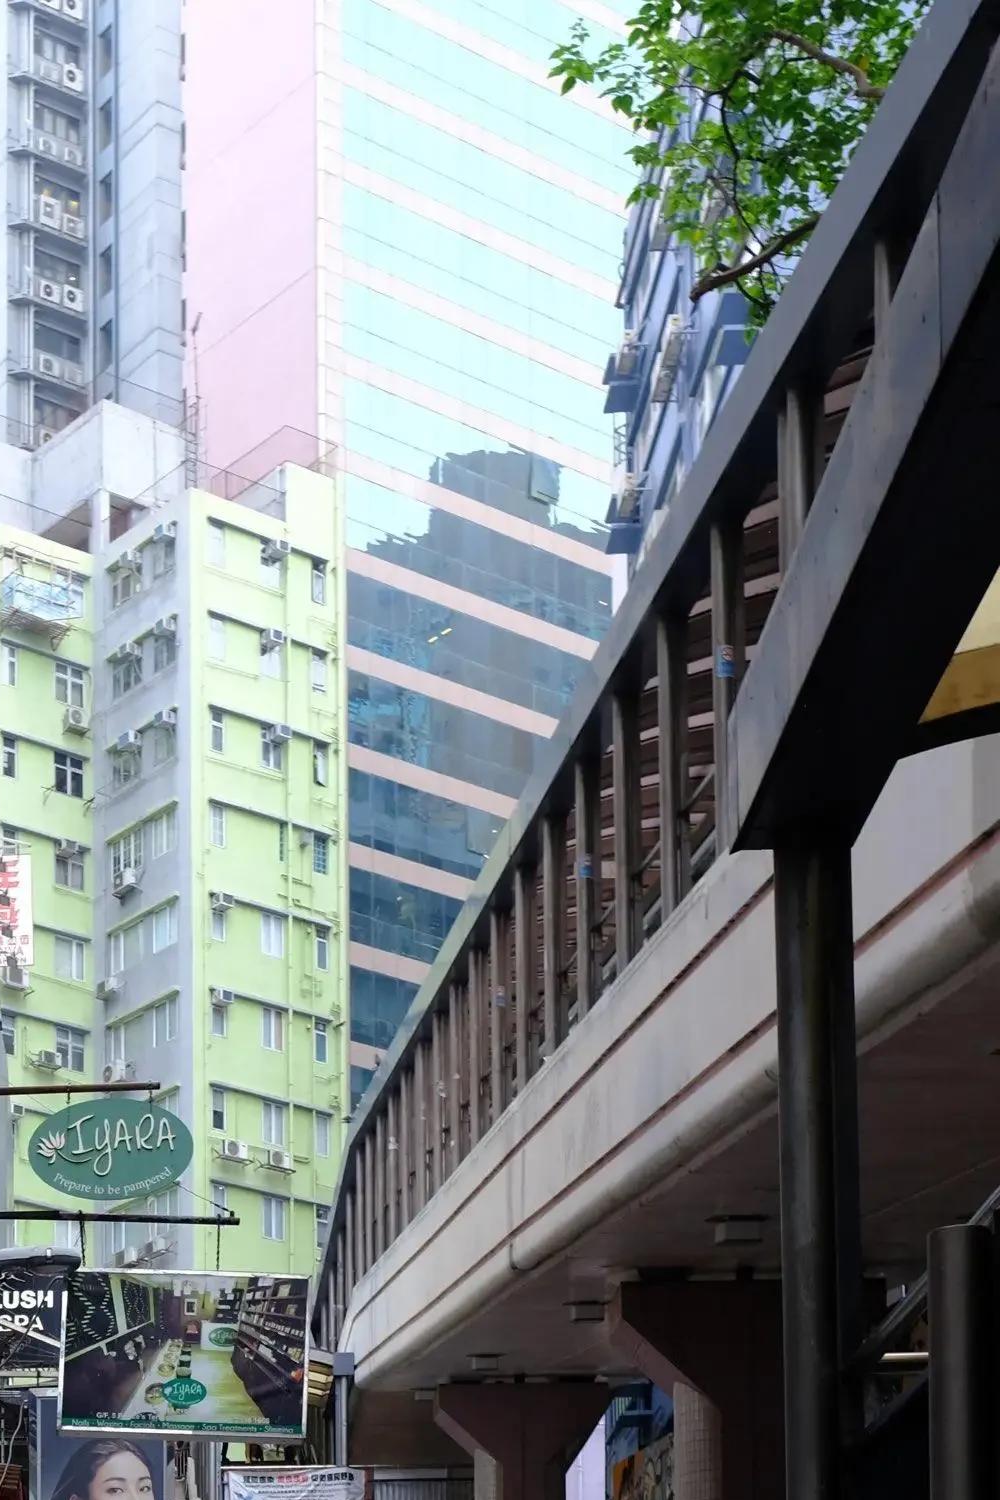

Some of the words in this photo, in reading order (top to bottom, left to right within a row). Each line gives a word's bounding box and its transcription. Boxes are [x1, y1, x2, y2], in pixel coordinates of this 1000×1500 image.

[53, 1172, 92, 1193] Prepare
[94, 1184, 105, 1195] to
[107, 1184, 121, 1195] be
[123, 1166, 173, 1196] pampered
[71, 1418, 90, 1427] Nails
[219, 1424, 258, 1433] Treatments
